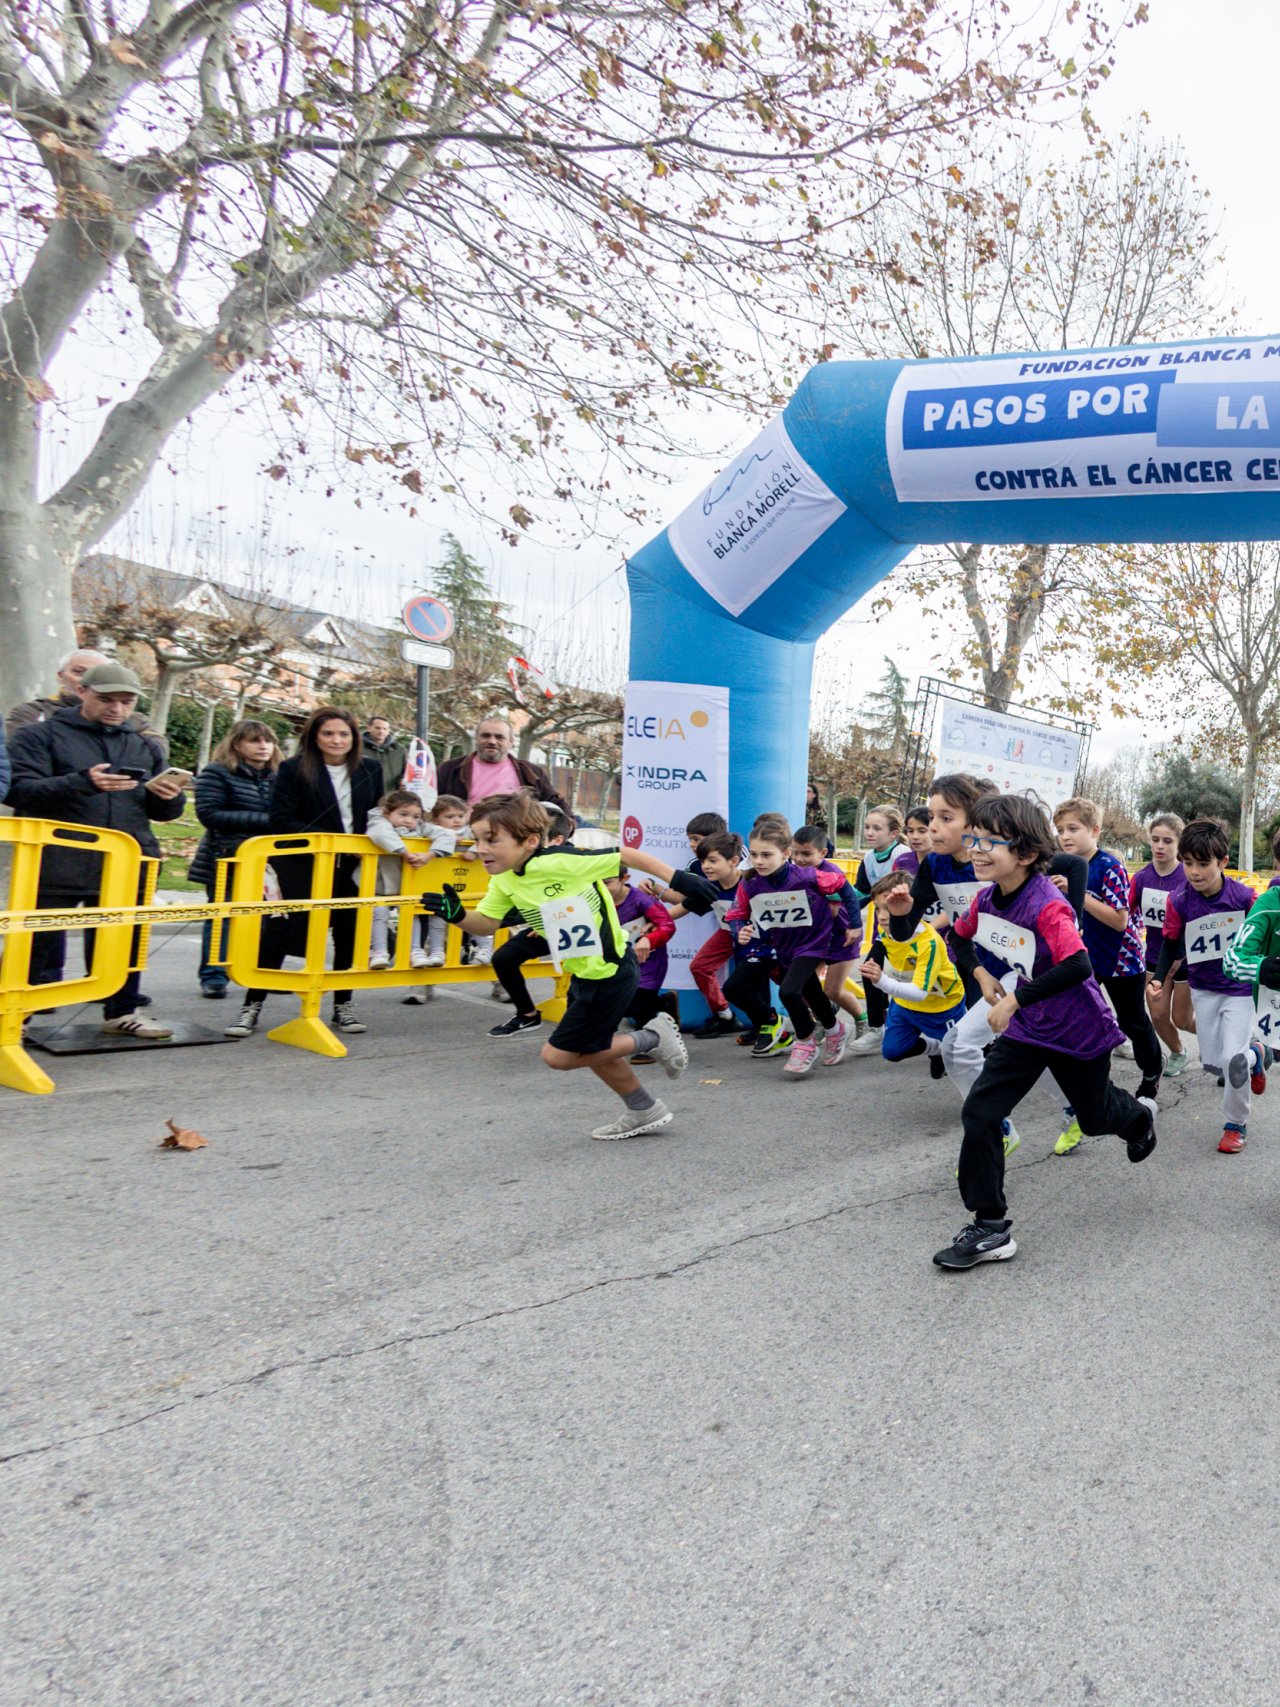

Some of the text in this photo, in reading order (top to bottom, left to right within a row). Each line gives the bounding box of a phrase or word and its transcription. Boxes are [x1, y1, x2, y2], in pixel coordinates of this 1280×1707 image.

[1018, 354, 1147, 377] FUNDACIÓN
[1158, 349, 1251, 366] BLANCA
[923, 383, 1148, 432] PASOS POR
[1215, 395, 1269, 430] LA
[975, 470, 1077, 491] CONTRA
[1087, 463, 1116, 487] EL
[1128, 455, 1232, 485] CÁNCER
[707, 461, 793, 548] FUNDACIÓN
[713, 472, 801, 560] BLANCA MORELL
[766, 517, 776, 532] que
[628, 716, 686, 740] ELEIA
[638, 766, 707, 782] INDRA
[638, 780, 681, 790] GROUP
[625, 827, 639, 842] QP
[760, 908, 807, 922] 472
[1145, 908, 1166, 922] 46
[1200, 921, 1227, 931] ELEIA
[990, 932, 1017, 950] ELEIA
